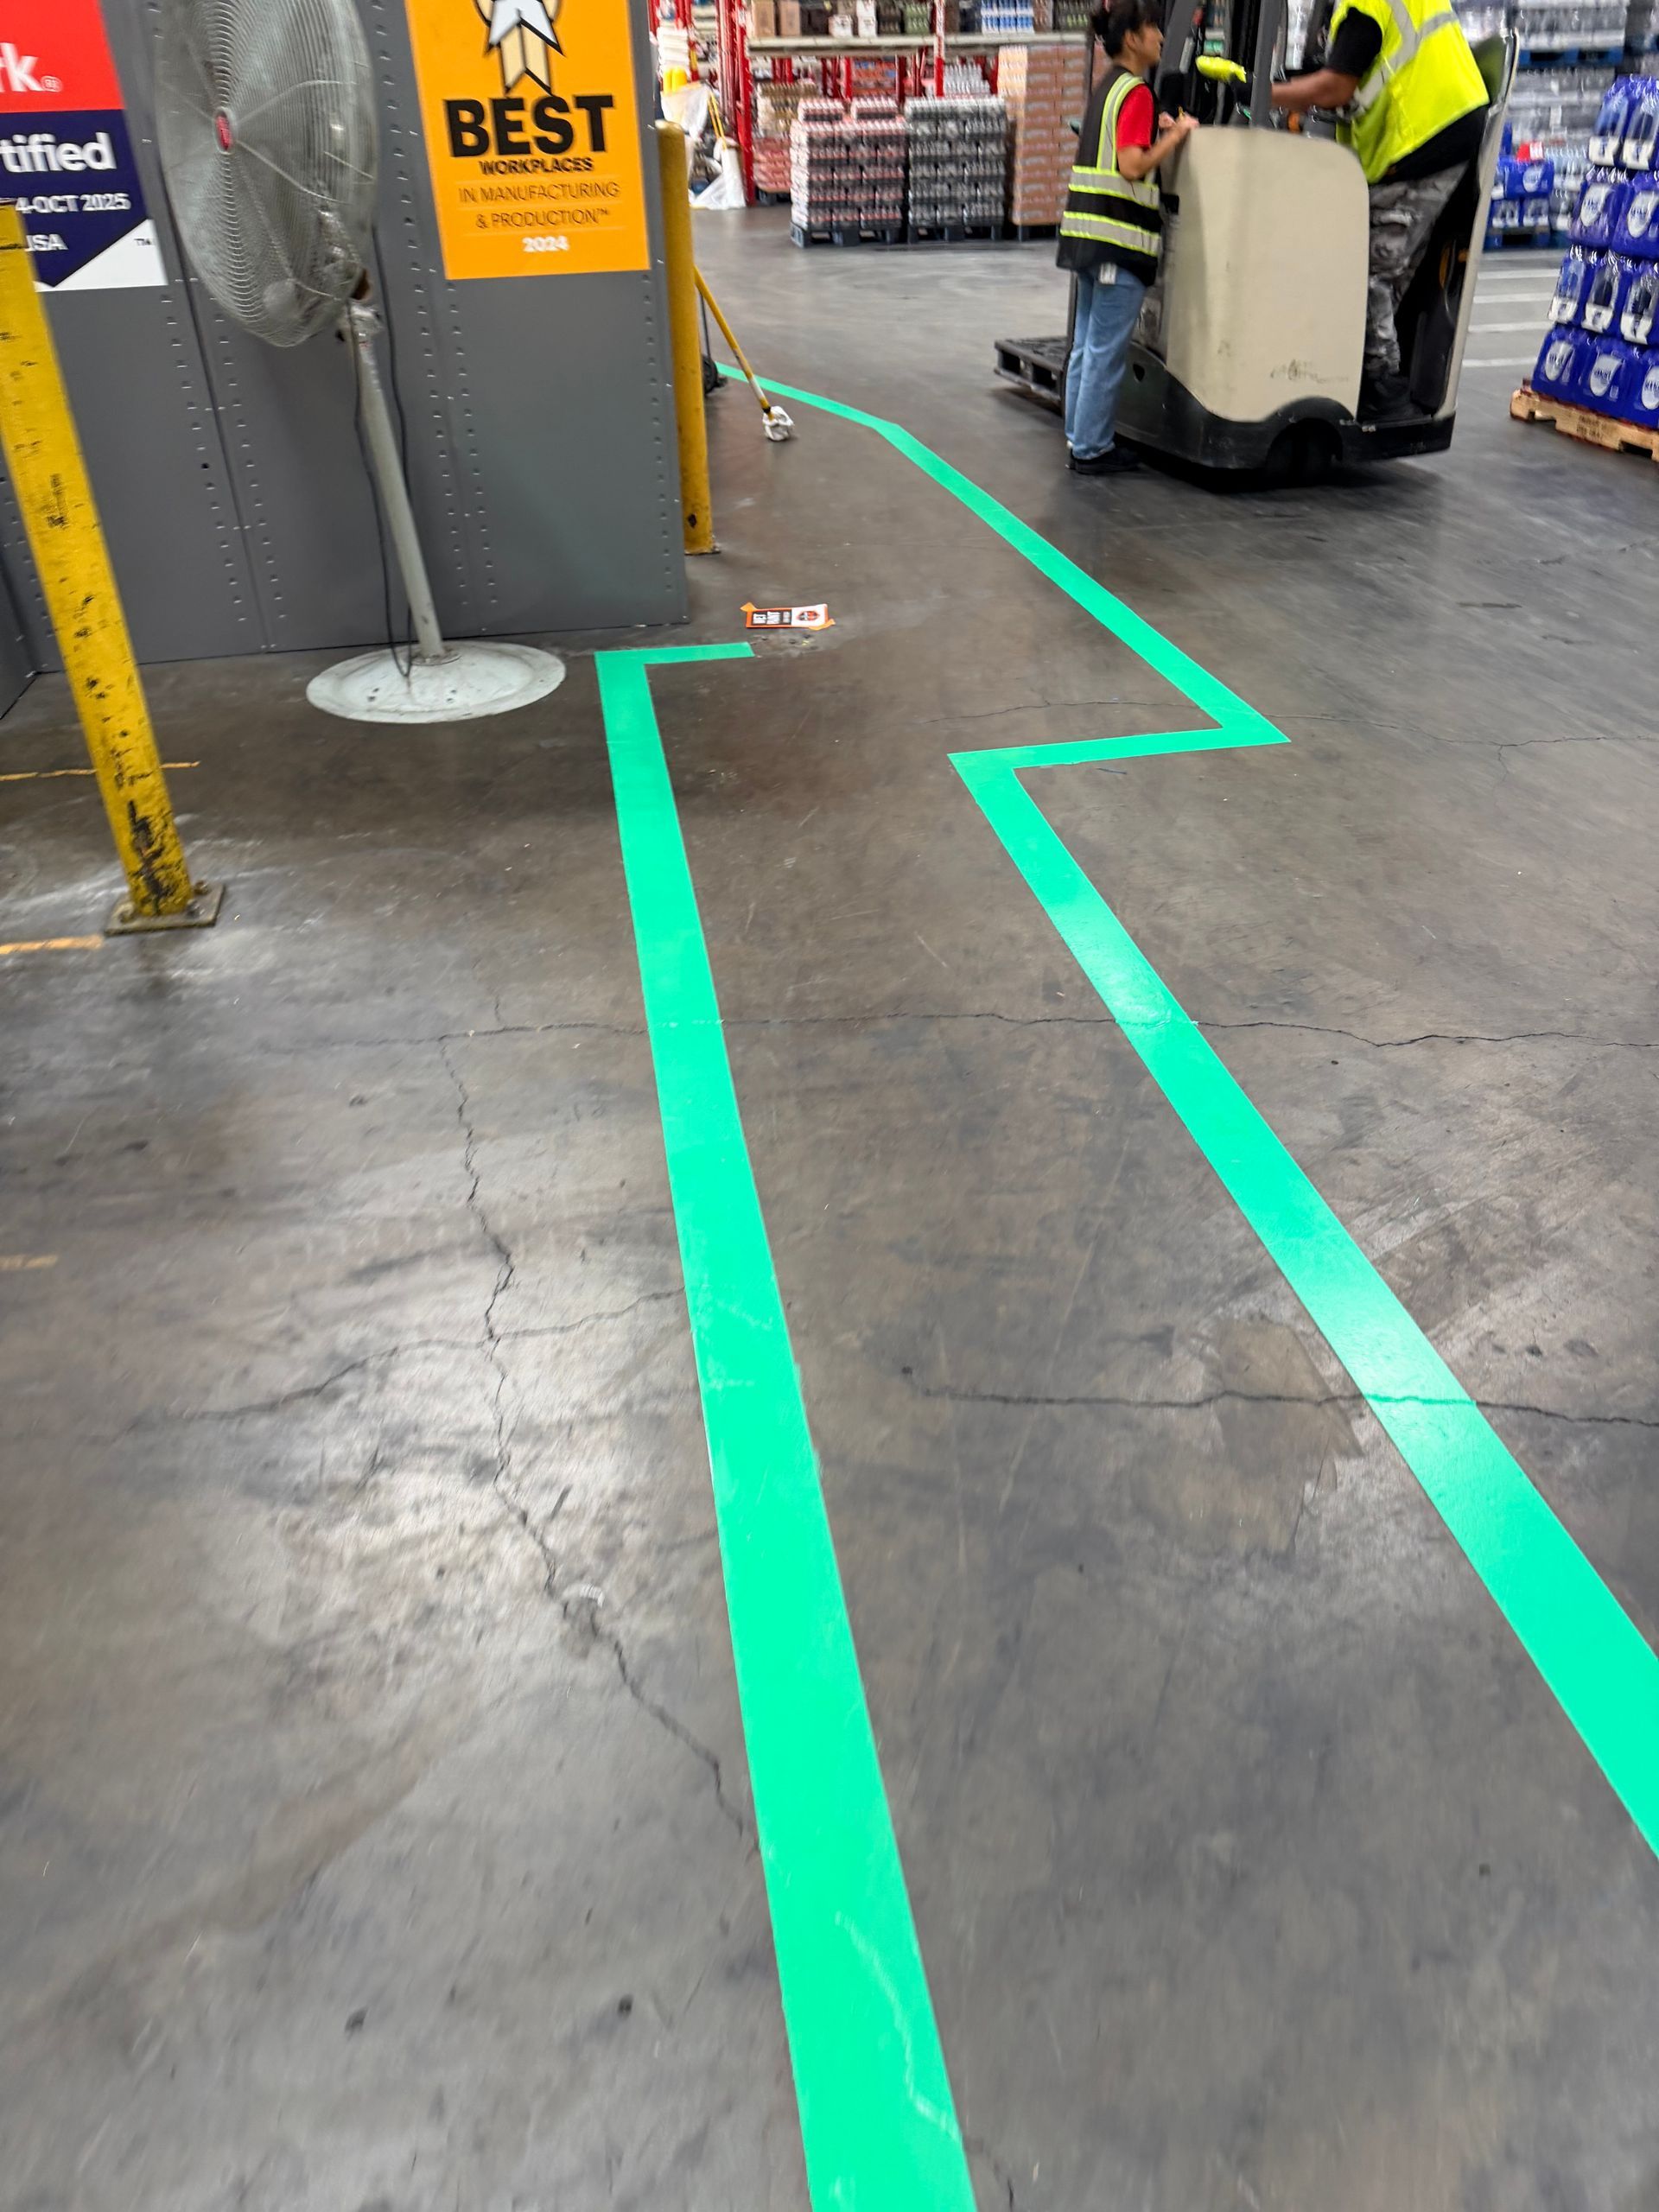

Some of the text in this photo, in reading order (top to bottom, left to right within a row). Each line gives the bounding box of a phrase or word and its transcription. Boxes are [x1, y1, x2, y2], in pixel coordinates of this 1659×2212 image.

[444, 95, 613, 158] BEST
[0, 132, 117, 172] tified
[479, 157, 594, 175] WORKPLACES
[459, 181, 620, 203] IN MANUFACTURING
[79, 193, 131, 212] 2025
[475, 213, 486, 229] &
[522, 235, 570, 253] 2024
